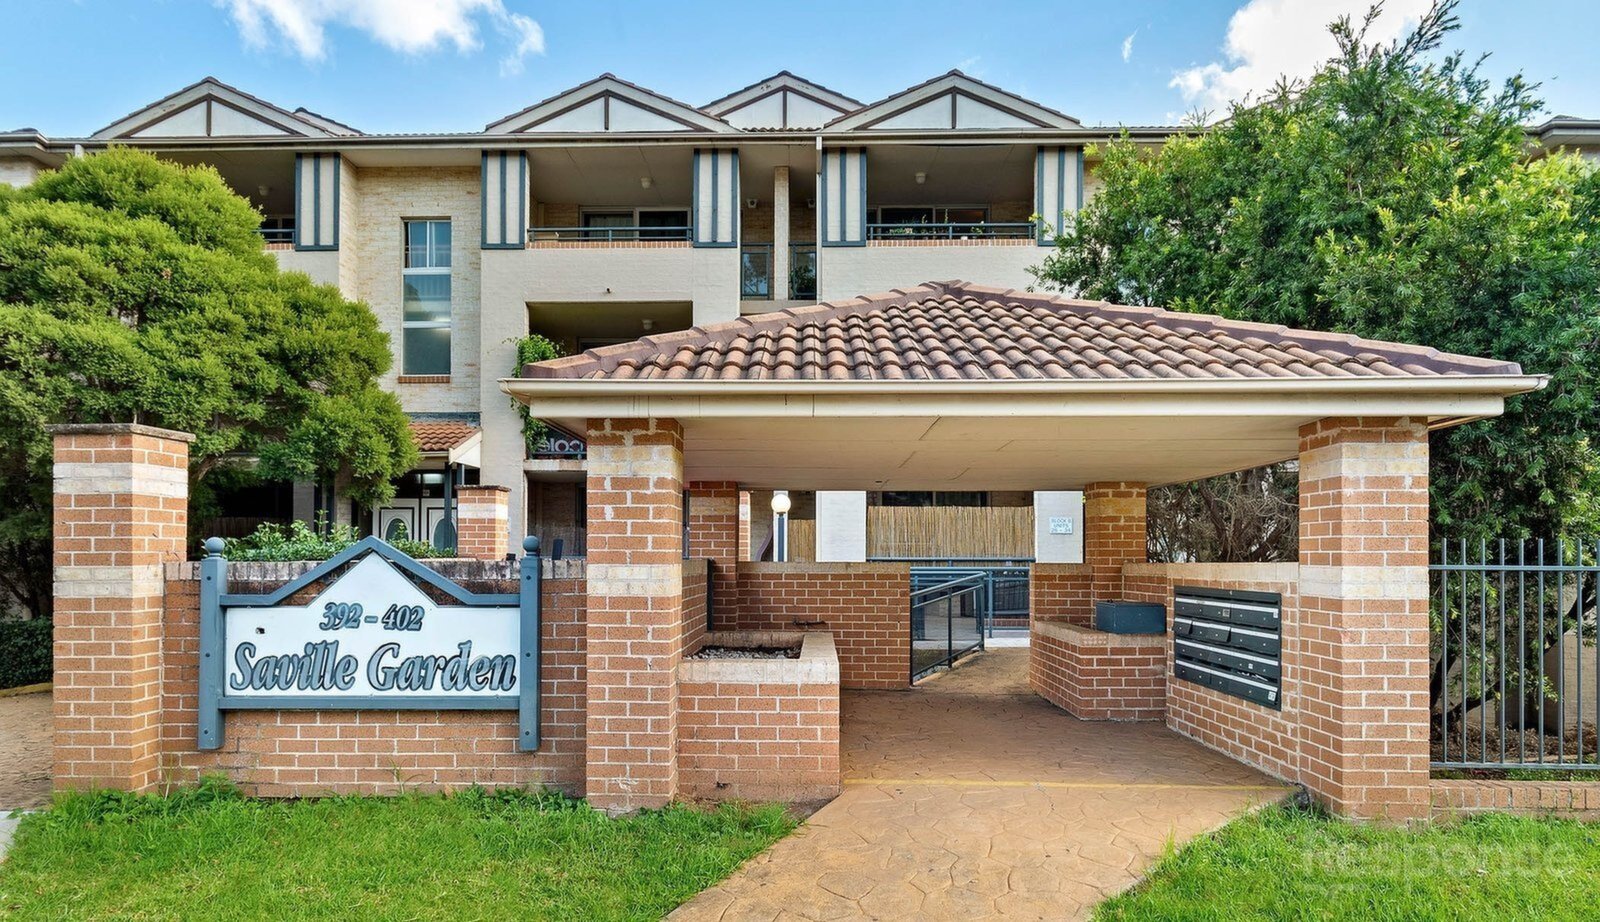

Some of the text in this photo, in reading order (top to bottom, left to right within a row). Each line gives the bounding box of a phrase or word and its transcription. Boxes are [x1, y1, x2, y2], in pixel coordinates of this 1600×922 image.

[319, 602, 364, 630] 392
[382, 604, 424, 631] 402
[230, 640, 517, 691] Saville Garden
